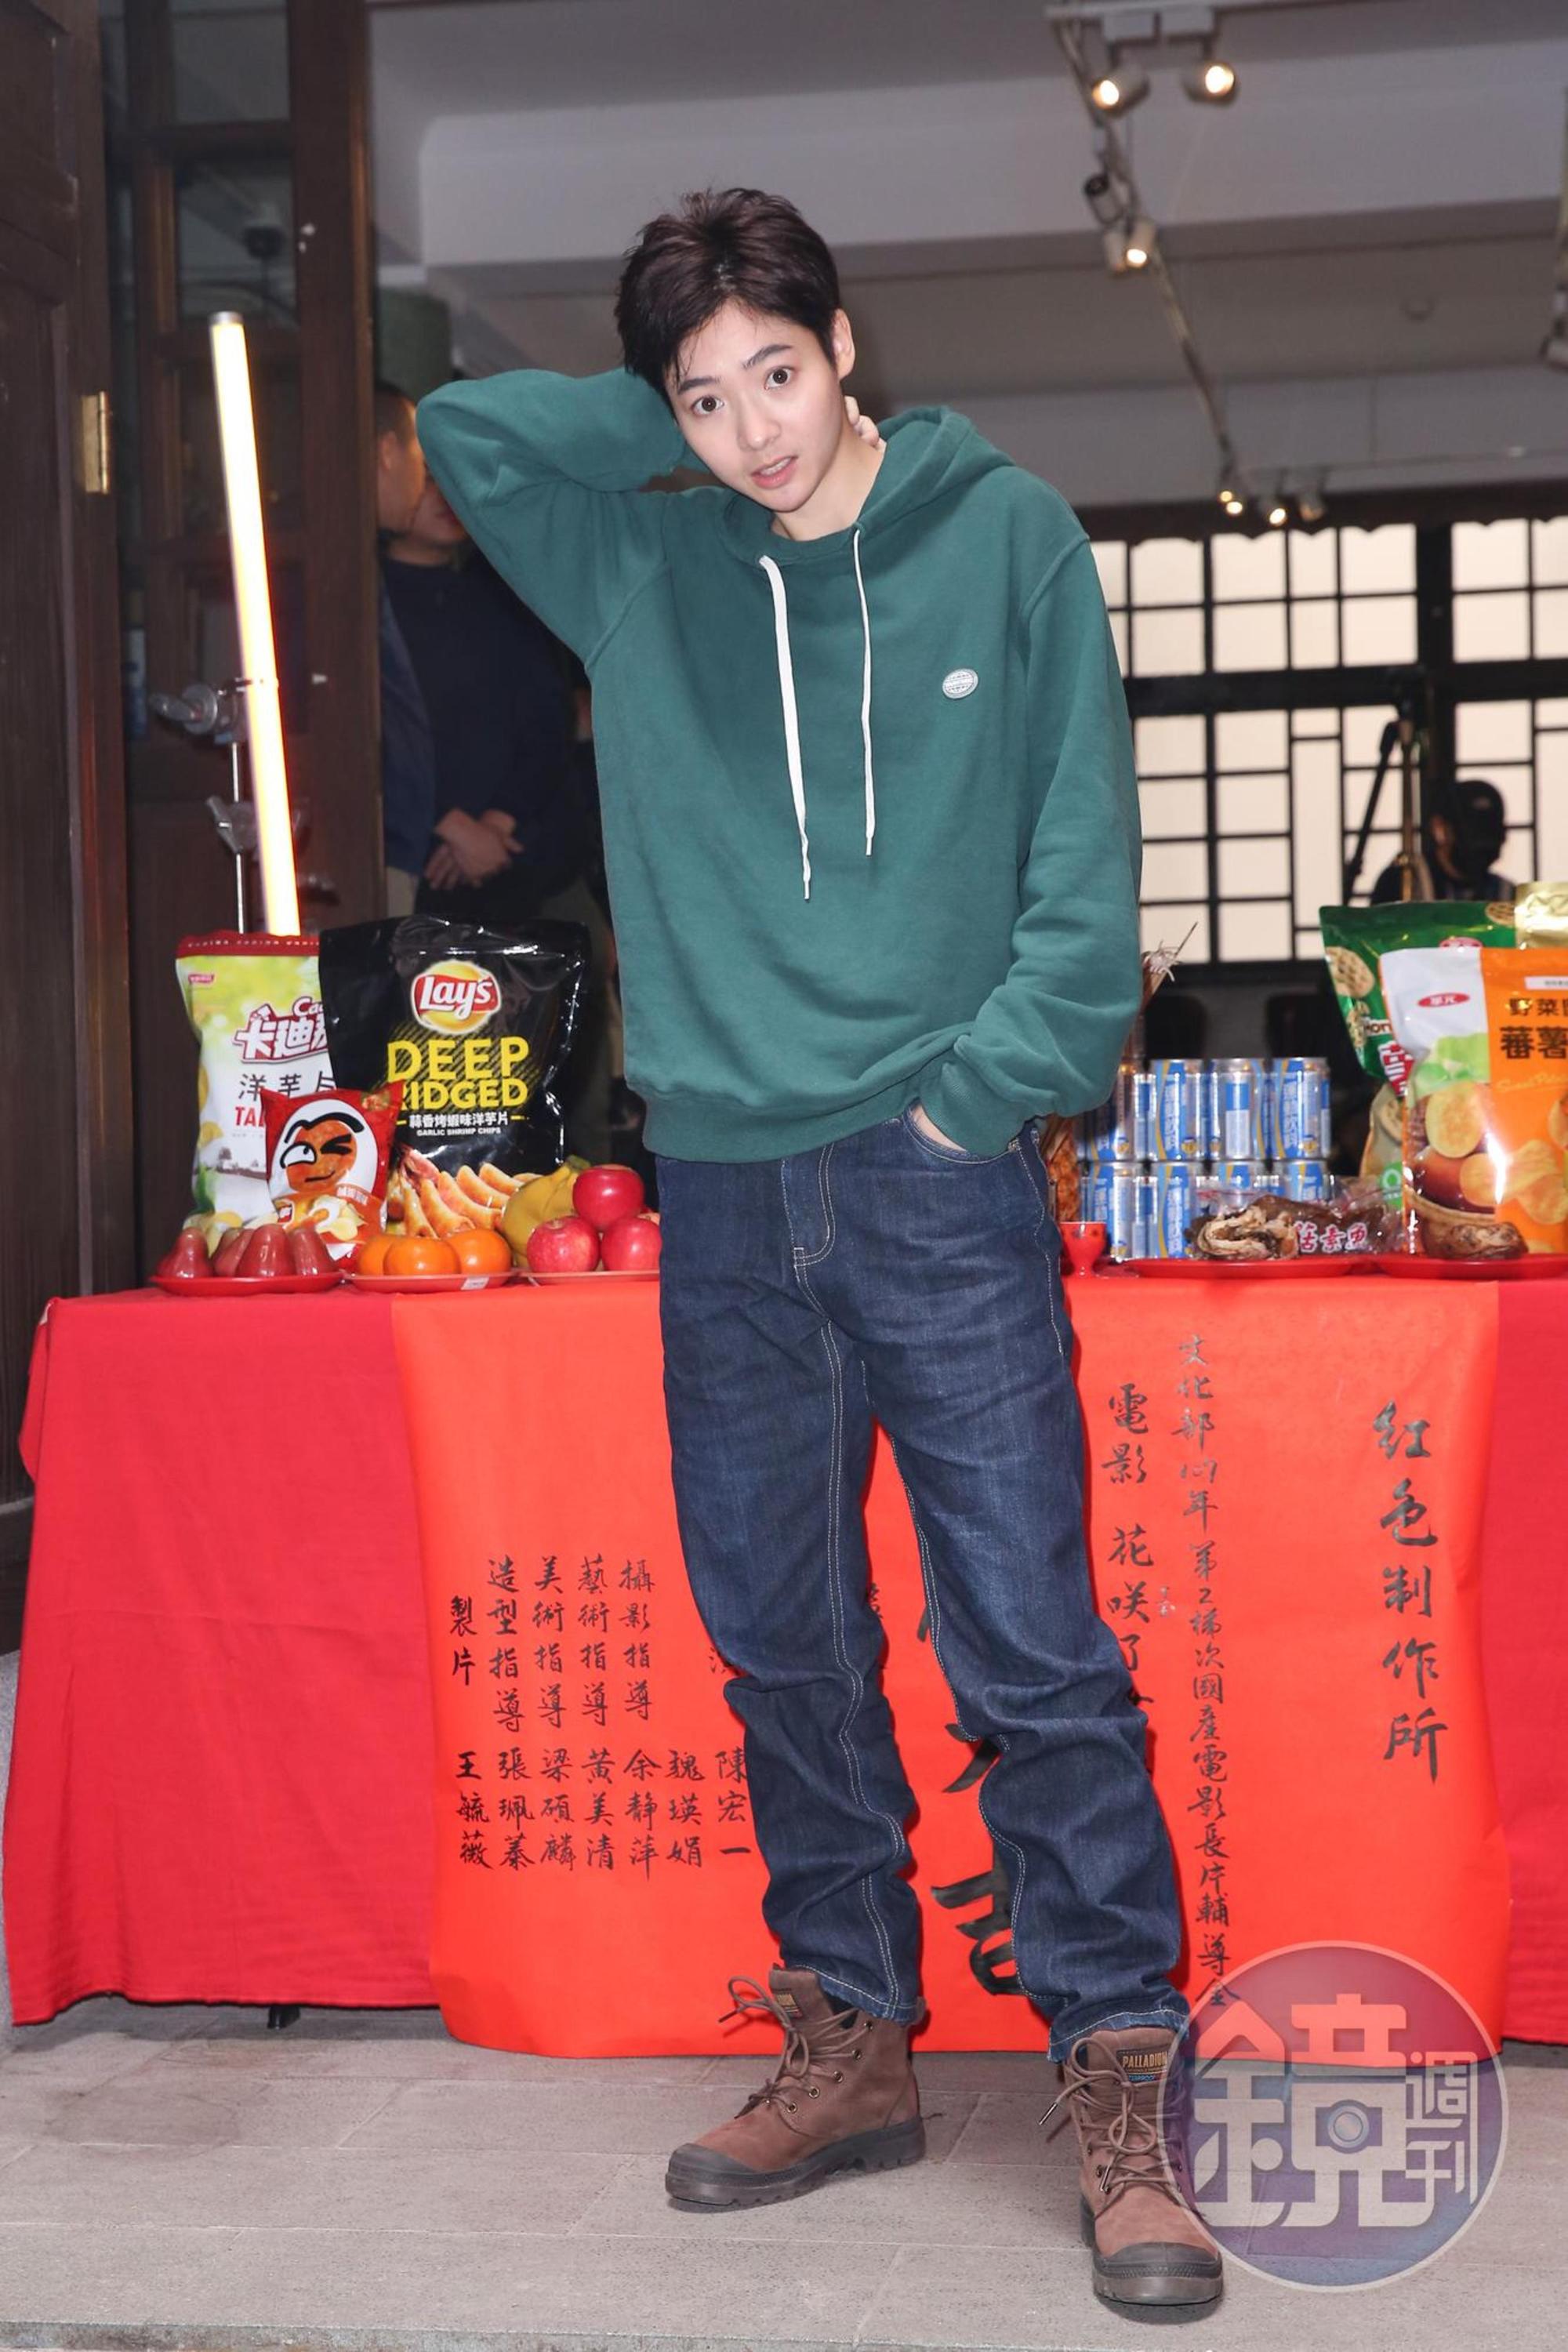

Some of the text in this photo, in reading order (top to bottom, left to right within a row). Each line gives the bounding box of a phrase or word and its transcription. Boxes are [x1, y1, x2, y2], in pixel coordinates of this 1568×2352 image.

[419, 975, 493, 1020] Lay's
[387, 1036, 529, 1082] DEEP
[409, 1112, 508, 1128] 蒜香烤蝦味洋芋片
[1102, 1383, 1149, 1484] 電影
[450, 1595, 477, 1686] 製片
[487, 1555, 524, 1733] 造型指導
[532, 1555, 567, 1730] 美術指導
[577, 1554, 610, 1726] 藝術指導
[619, 1559, 655, 1721] 攝影指導
[715, 1746, 751, 1856] 陳宏一
